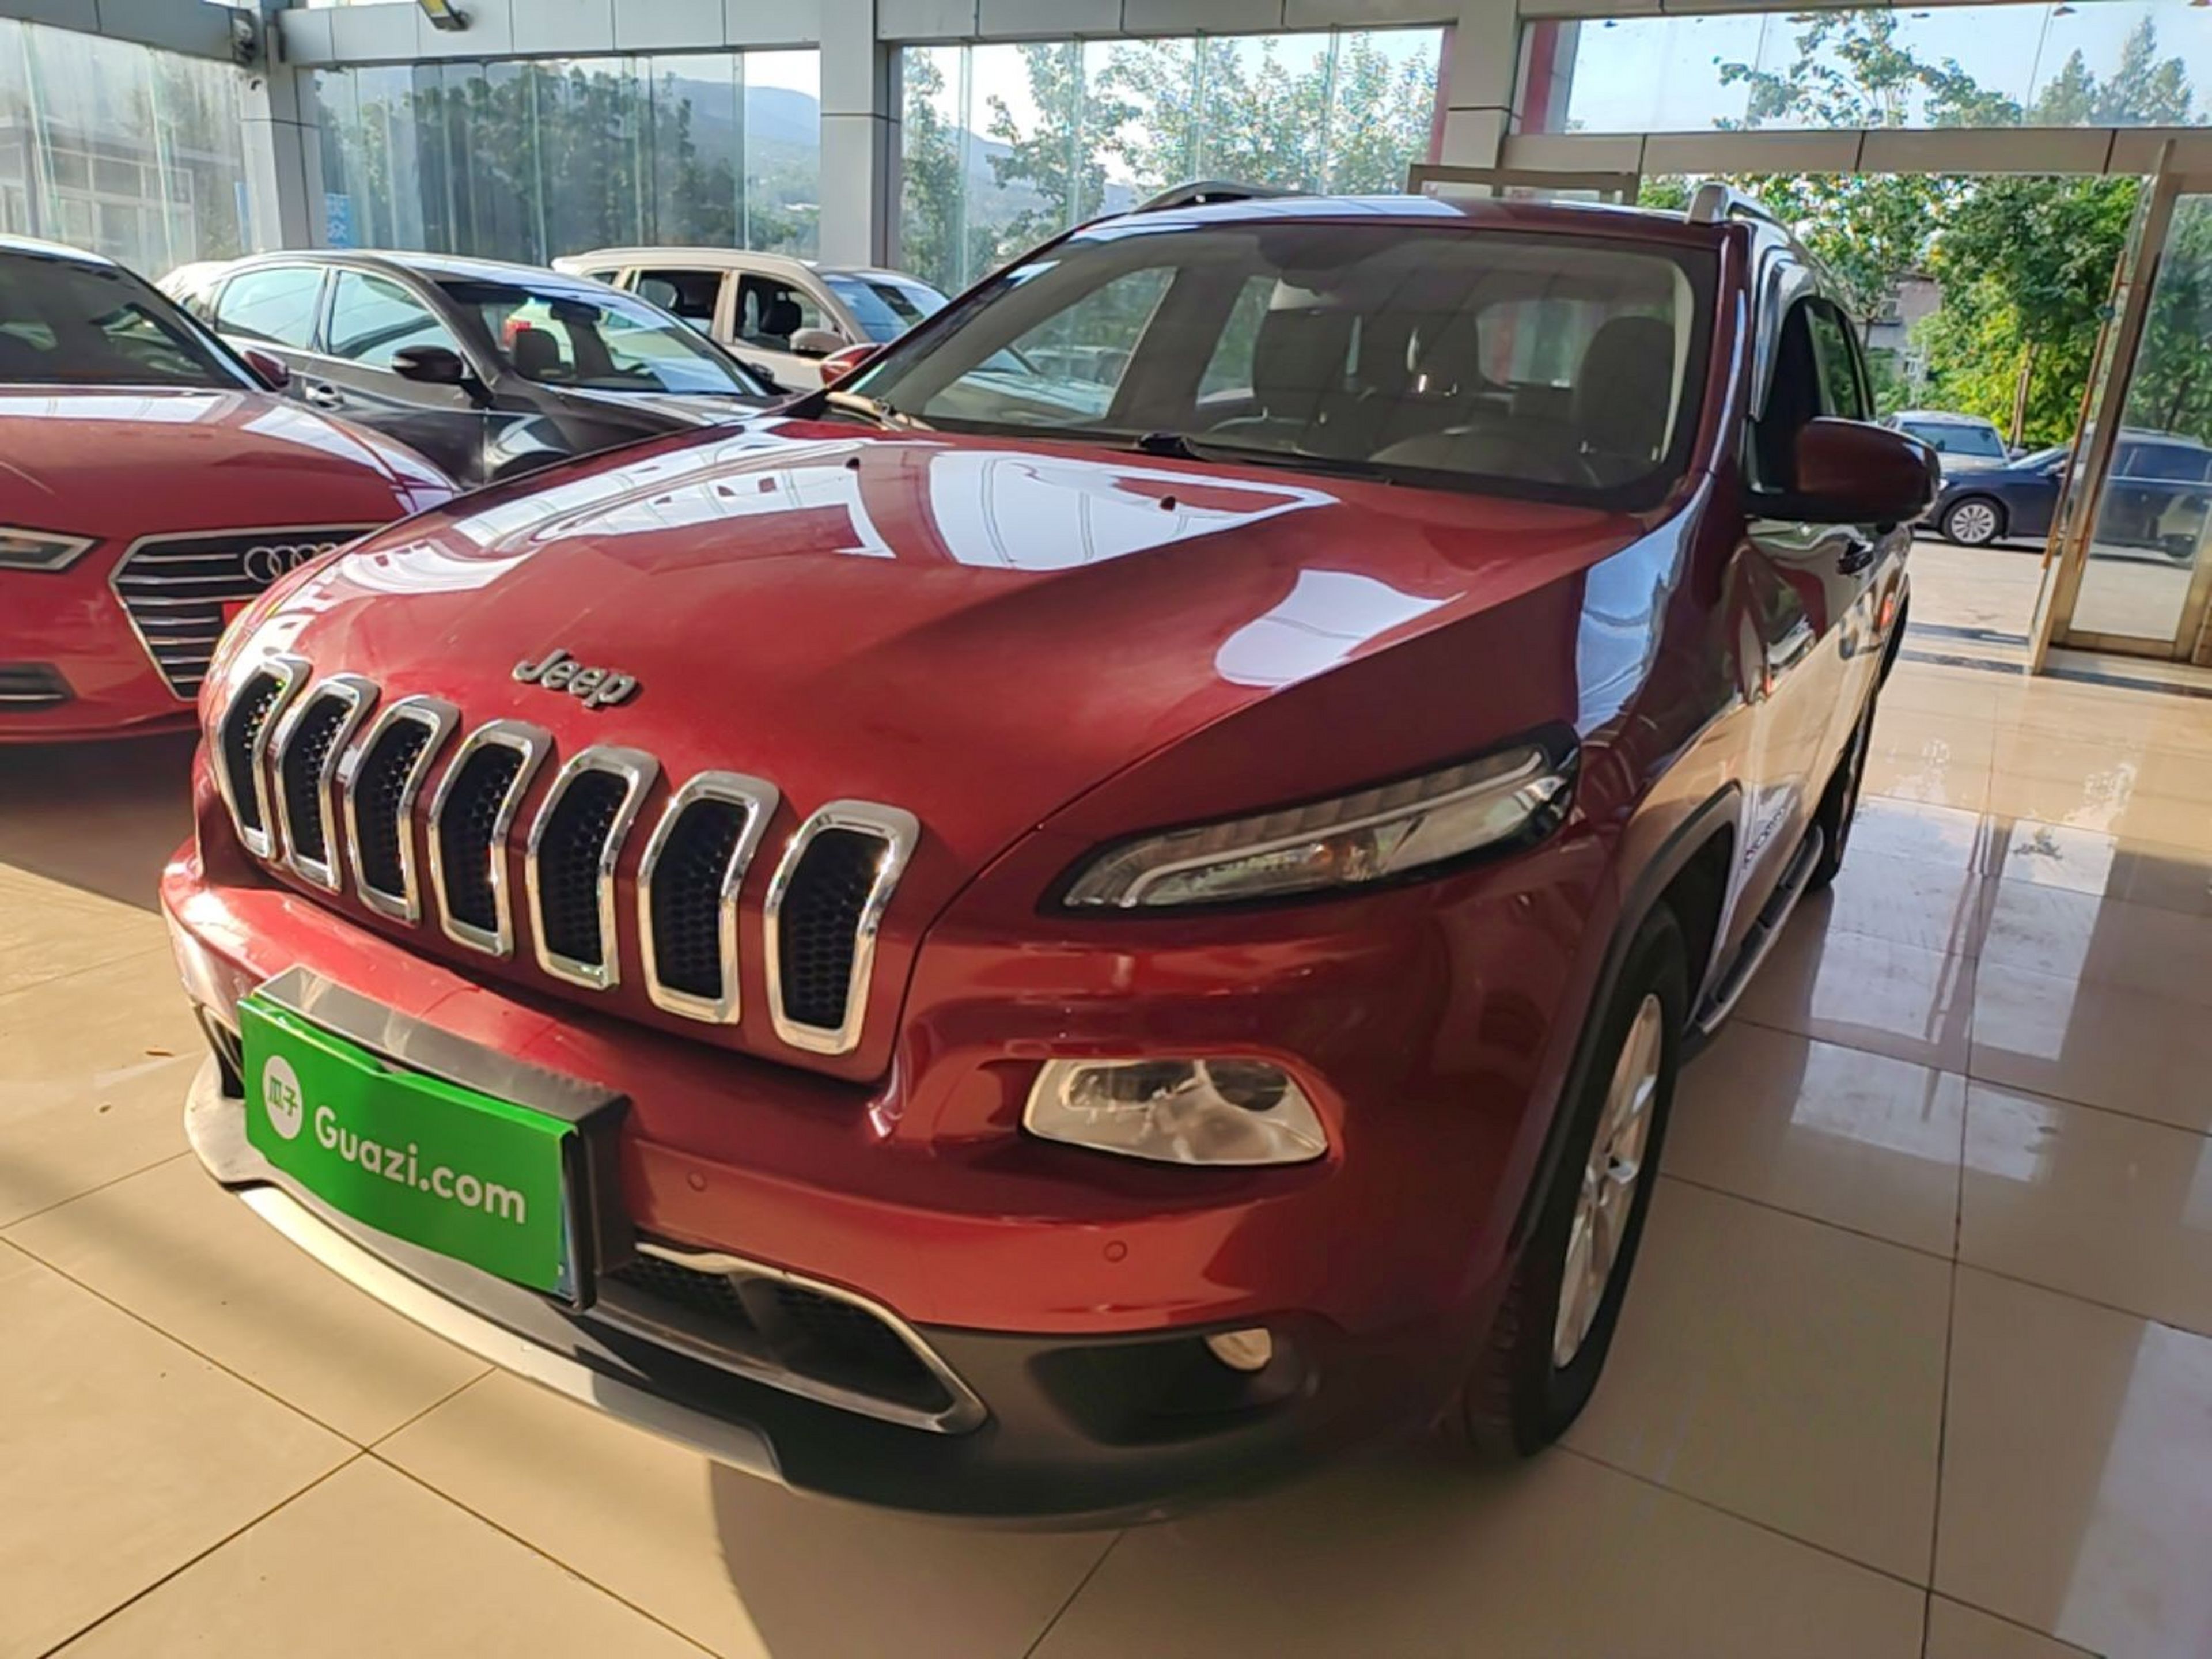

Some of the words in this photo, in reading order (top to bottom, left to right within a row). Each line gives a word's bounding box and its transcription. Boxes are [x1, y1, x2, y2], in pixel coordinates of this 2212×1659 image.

[512, 649, 636, 708] Jeep
[270, 1075, 298, 1117] 瓜子
[315, 1105, 525, 1224] Guazi.com
